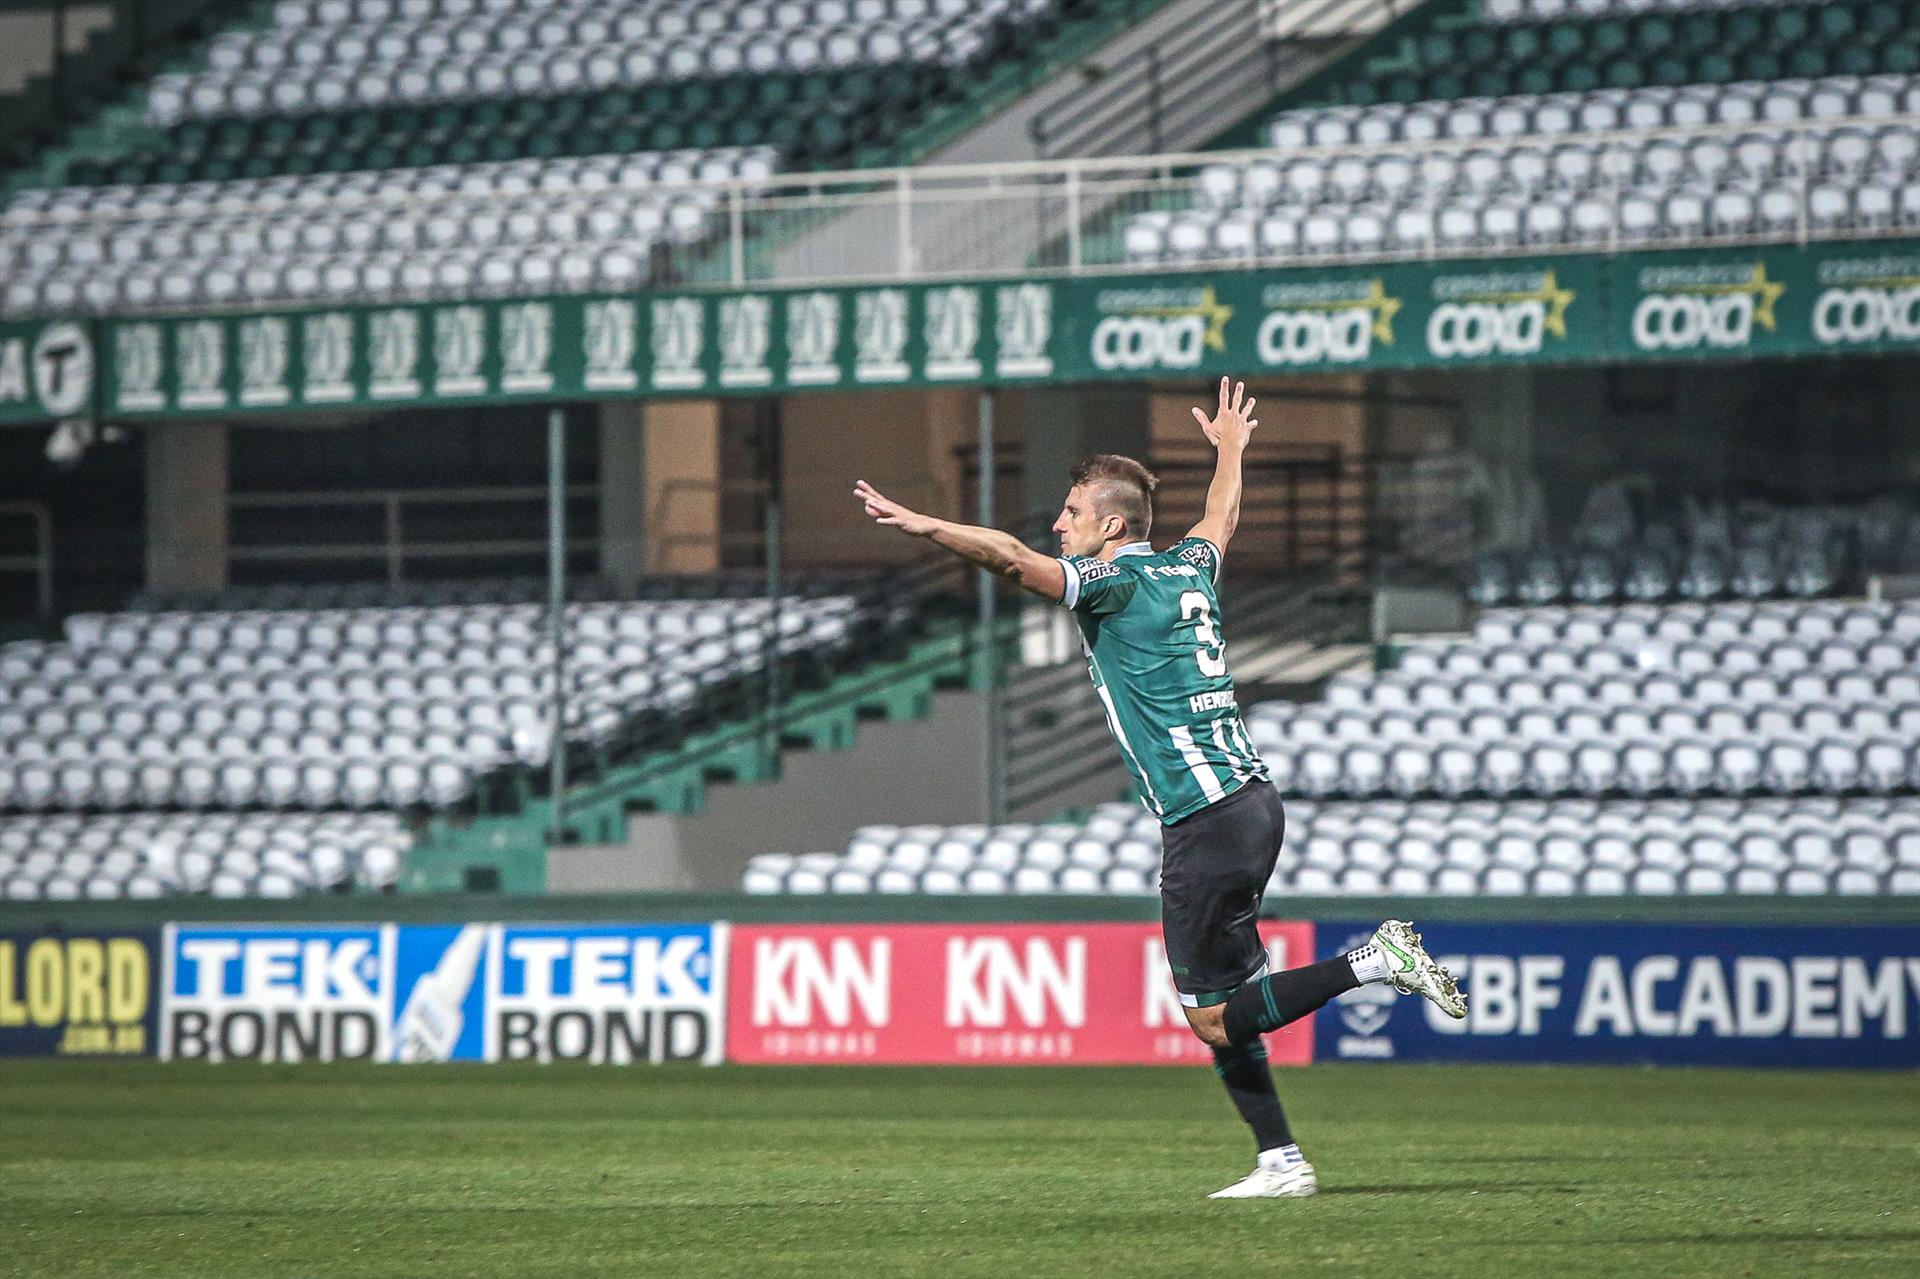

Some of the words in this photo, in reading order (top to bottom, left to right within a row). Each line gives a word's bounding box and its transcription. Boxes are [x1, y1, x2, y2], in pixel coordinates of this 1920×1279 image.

[1091, 316, 1204, 369] COXA
[1257, 311, 1371, 365] COXA
[1427, 302, 1543, 358] COXA
[1632, 294, 1752, 350] COXA
[1179, 590, 1227, 678] 3
[181, 938, 372, 998] TEK
[509, 937, 703, 998] TEK
[754, 935, 892, 1028] KNN
[946, 935, 1087, 1028] KNN
[172, 1006, 378, 1058] BOND
[499, 1006, 709, 1059] BOND
